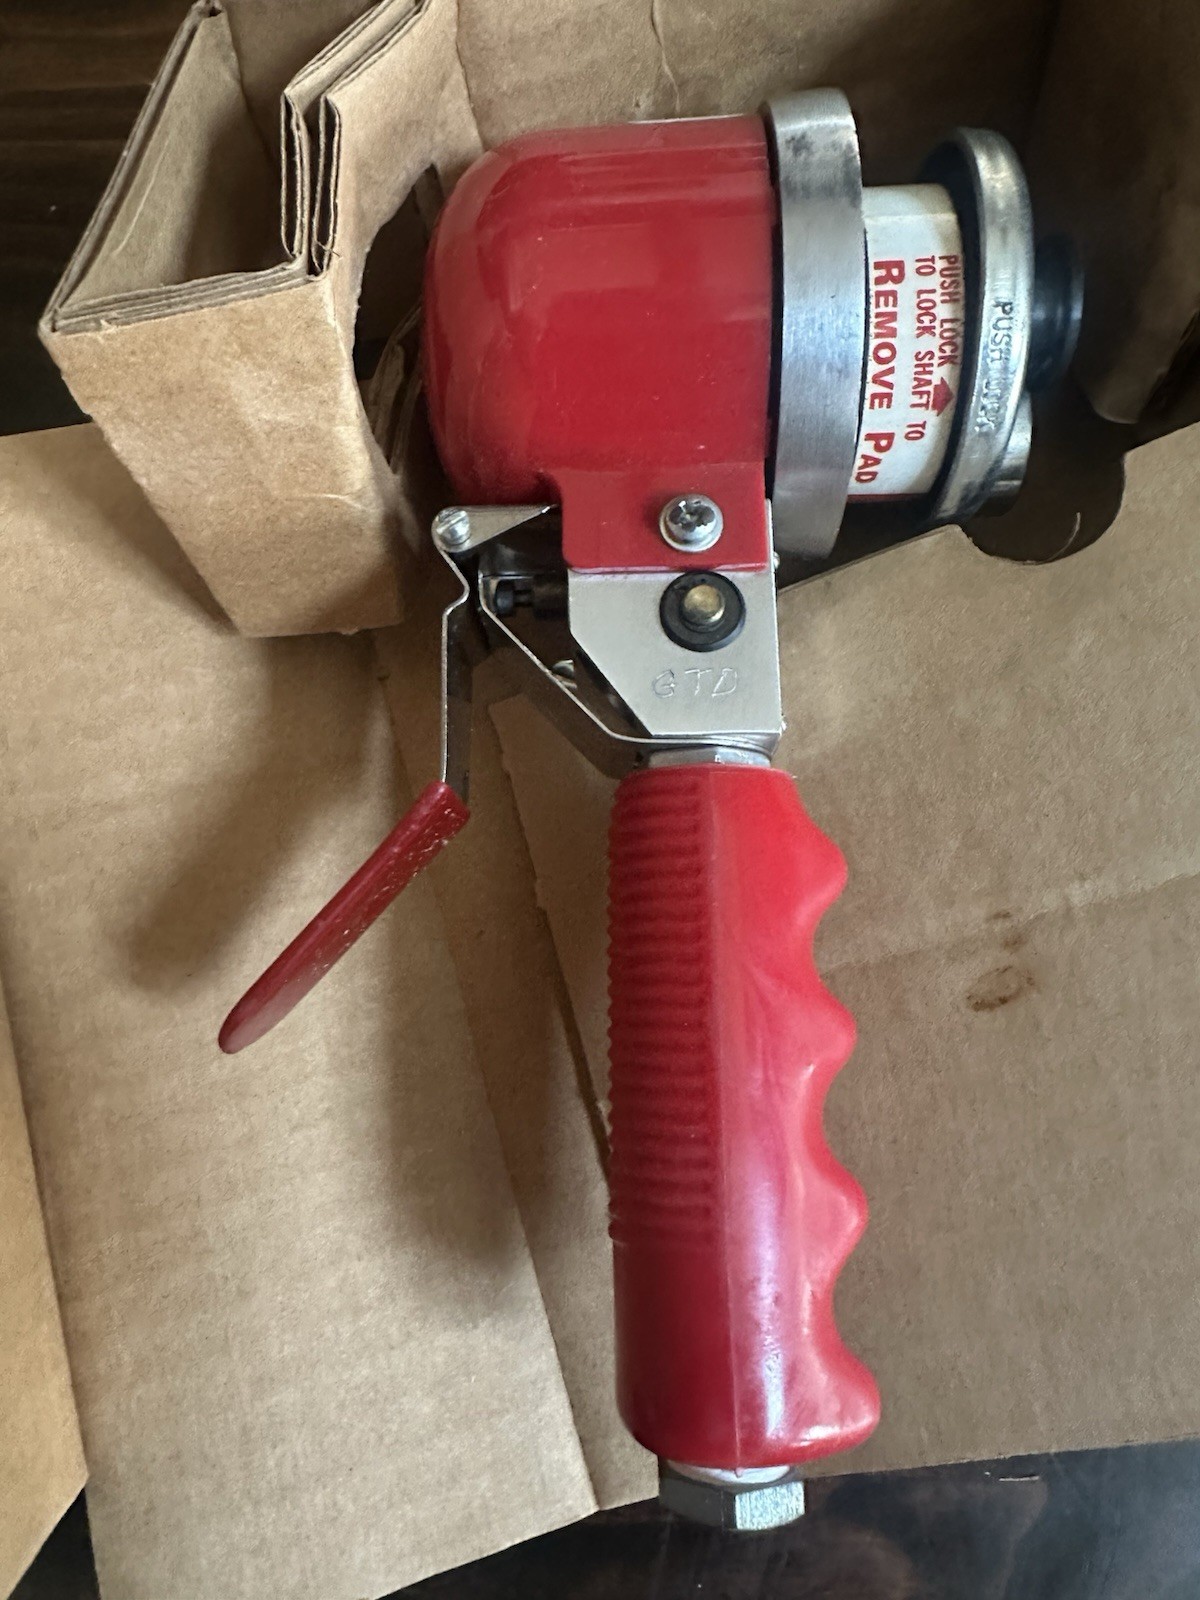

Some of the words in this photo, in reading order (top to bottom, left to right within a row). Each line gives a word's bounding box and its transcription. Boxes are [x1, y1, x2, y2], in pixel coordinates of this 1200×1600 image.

[914, 255, 936, 277] TO
[938, 255, 962, 304] PUSH
[869, 259, 906, 410] REMOVE
[915, 289, 937, 339] LOCK
[990, 301, 1014, 363] PUSH
[937, 318, 960, 367] LOCK
[909, 350, 935, 411] SHAFT
[903, 420, 927, 441] TO
[855, 431, 896, 484] PAD
